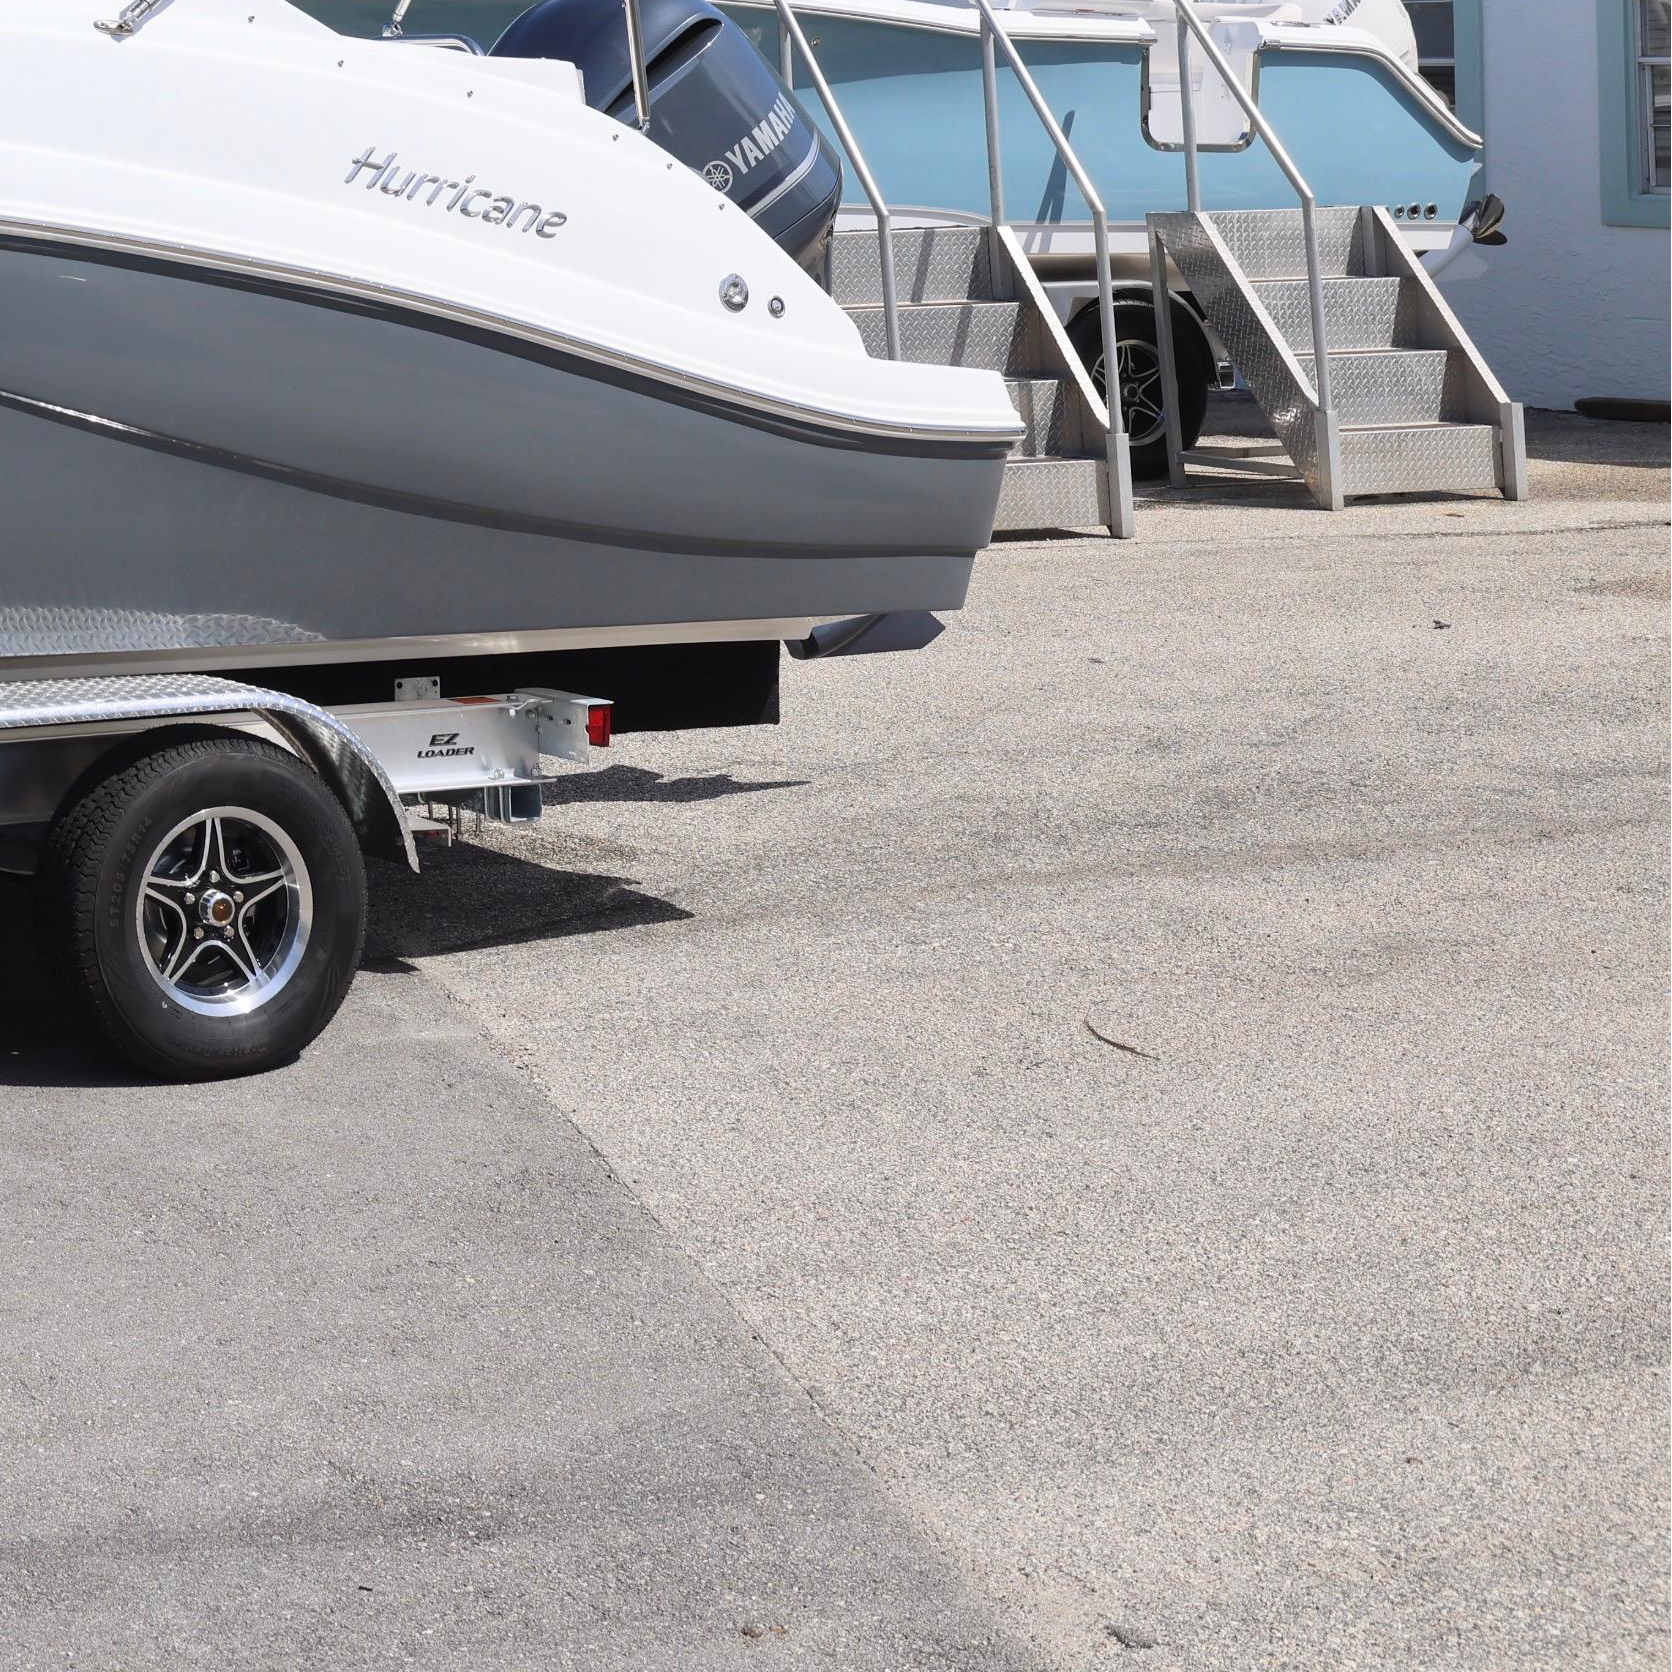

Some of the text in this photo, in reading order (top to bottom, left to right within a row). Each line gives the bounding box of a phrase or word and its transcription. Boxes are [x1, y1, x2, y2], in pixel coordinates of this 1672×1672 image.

[724, 90, 796, 175] YAMAHA
[343, 146, 568, 239] Hurricane
[417, 746, 475, 759] LOADER
[428, 732, 460, 747] EZ
